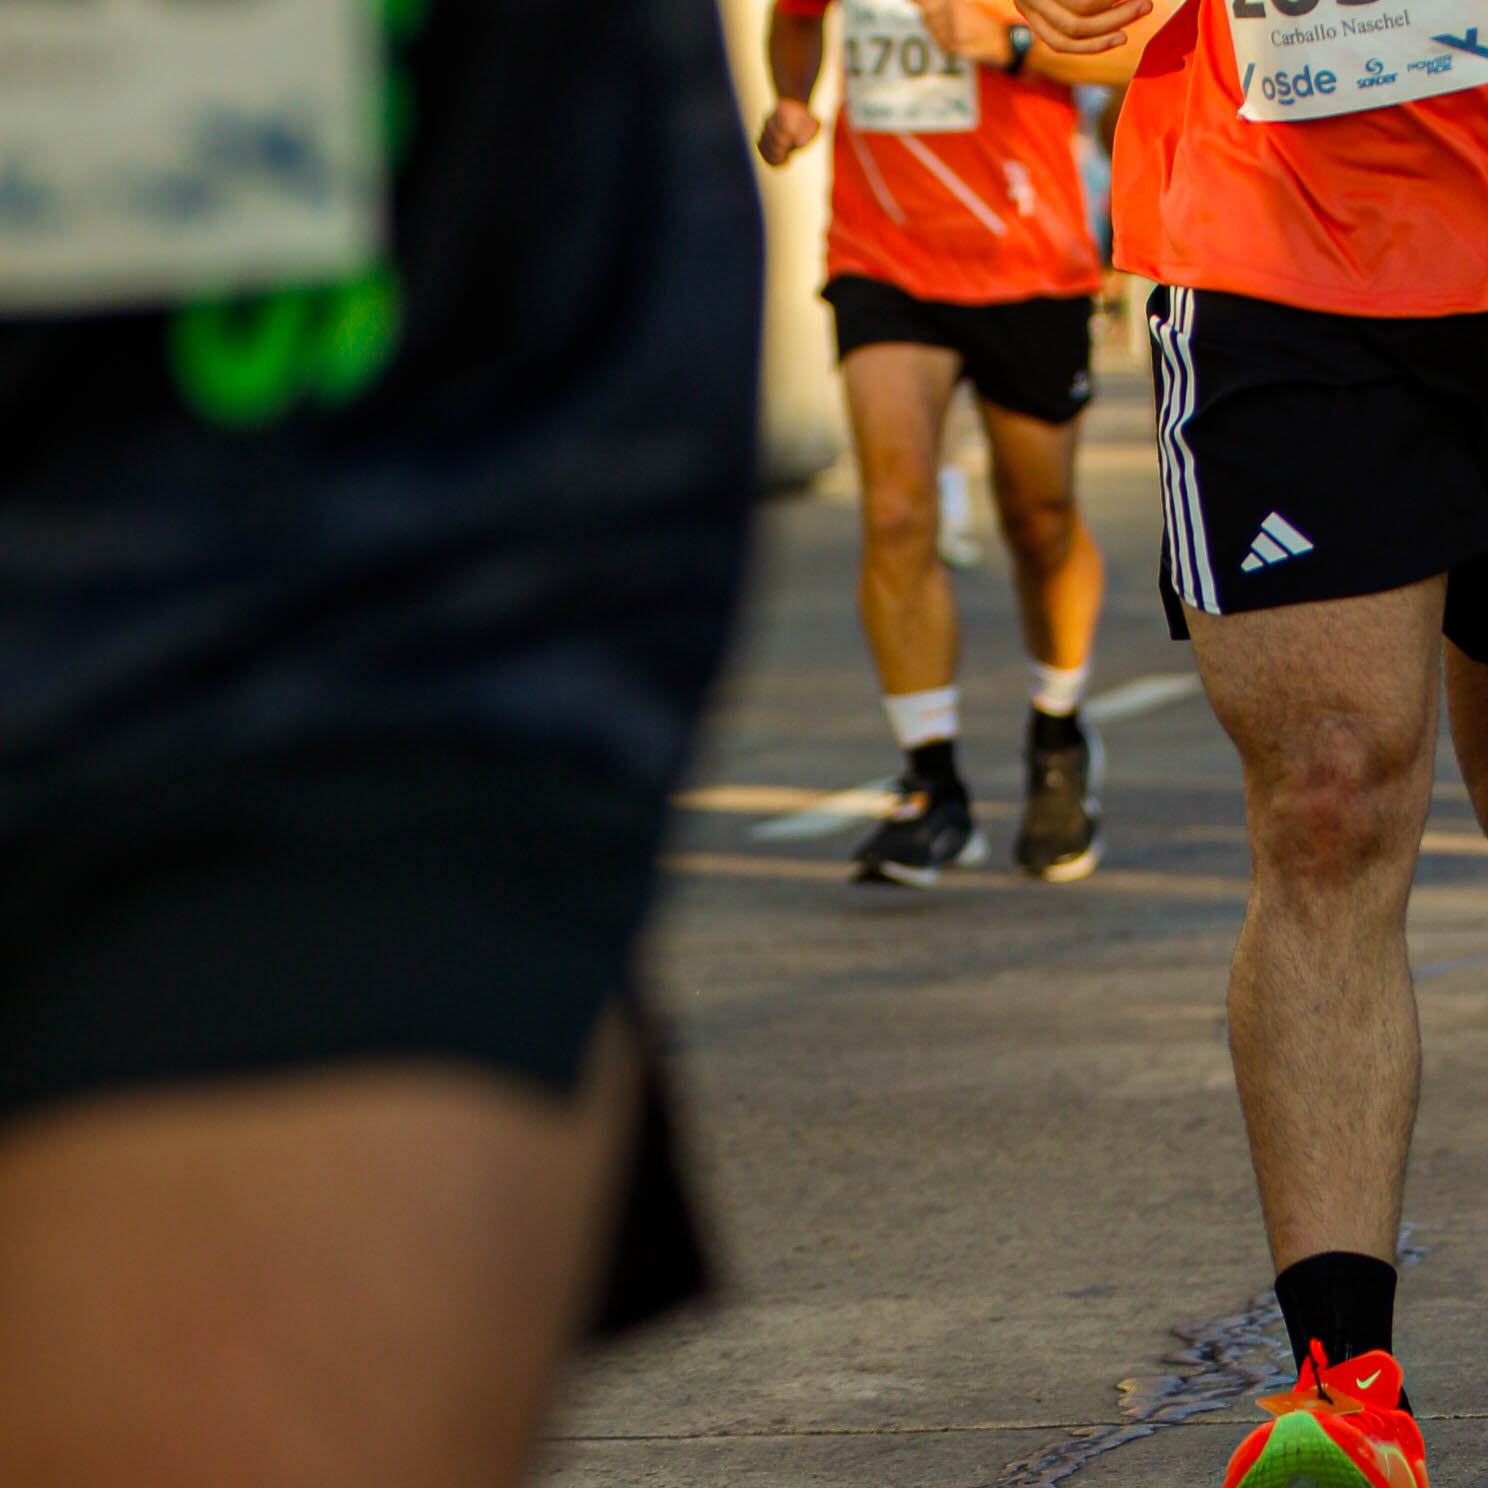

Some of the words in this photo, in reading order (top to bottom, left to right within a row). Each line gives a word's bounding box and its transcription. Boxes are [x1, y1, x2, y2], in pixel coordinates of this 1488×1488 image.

[1270, 23, 1337, 47] Carballo
[1341, 9, 1411, 37] Naschel
[1262, 63, 1337, 102] osde
